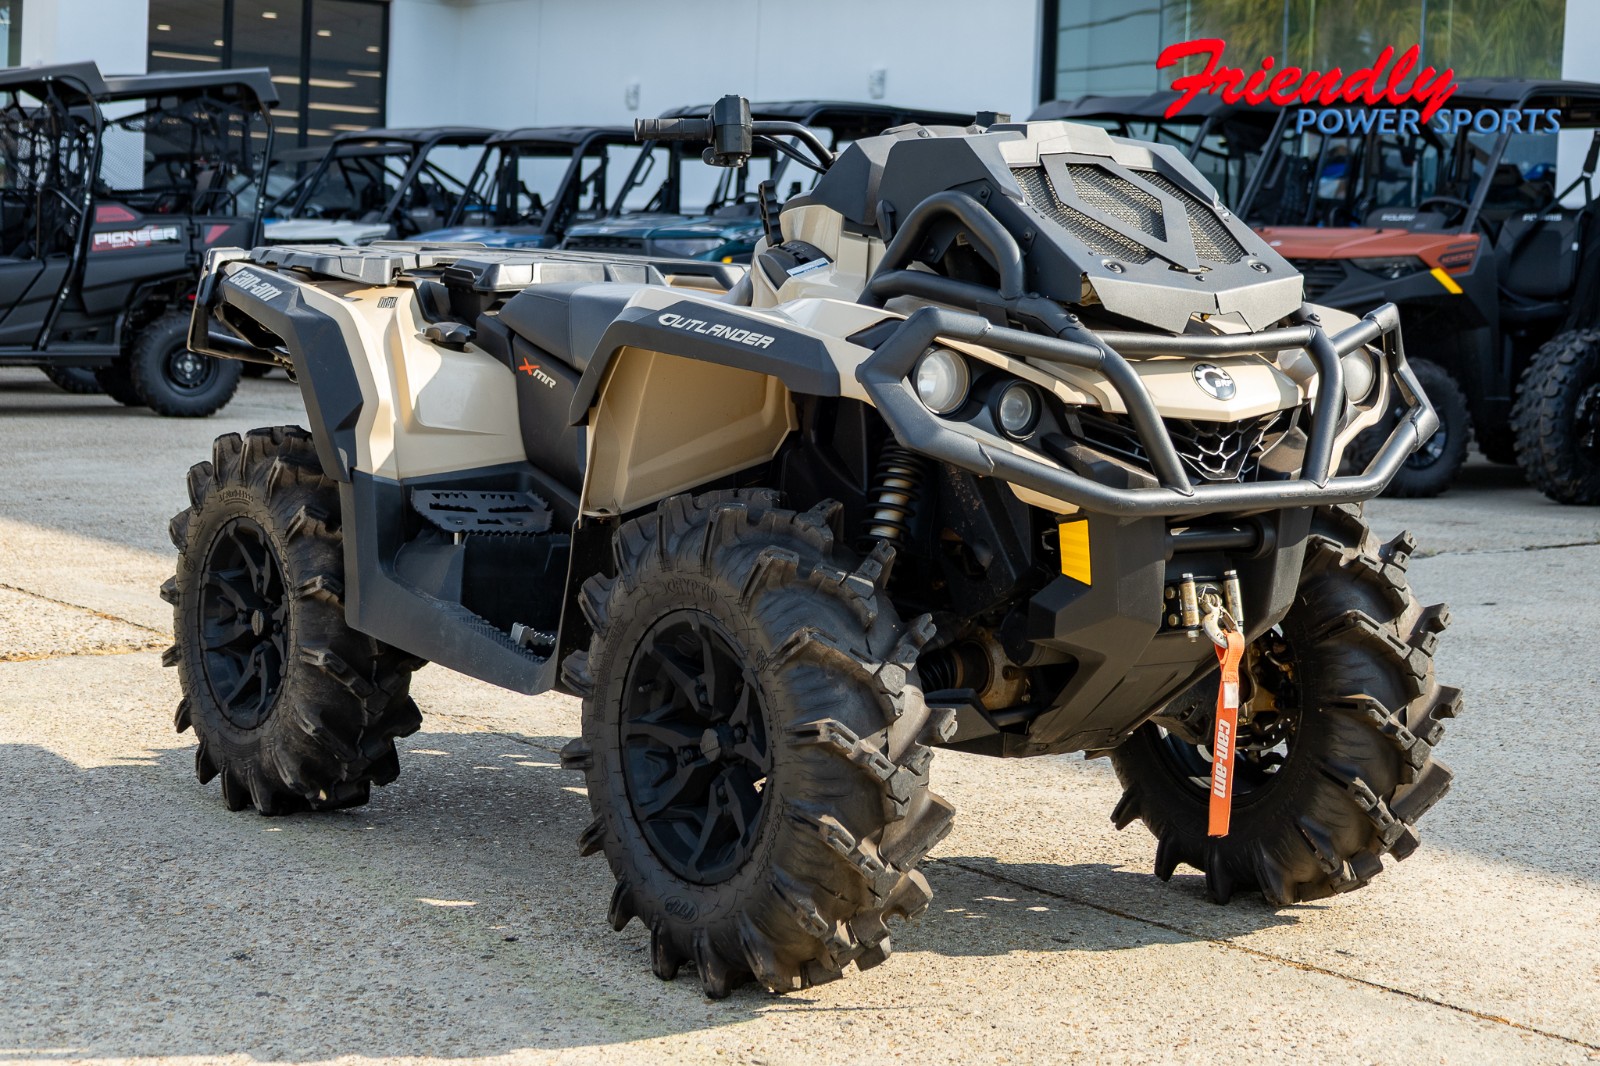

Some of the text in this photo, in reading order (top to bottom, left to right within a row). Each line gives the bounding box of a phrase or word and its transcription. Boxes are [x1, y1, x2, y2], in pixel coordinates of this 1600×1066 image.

[94, 227, 178, 246] PIONEER
[228, 269, 284, 302] can-am
[658, 313, 775, 349] OUTLANDER
[1213, 718, 1231, 799] can-am
